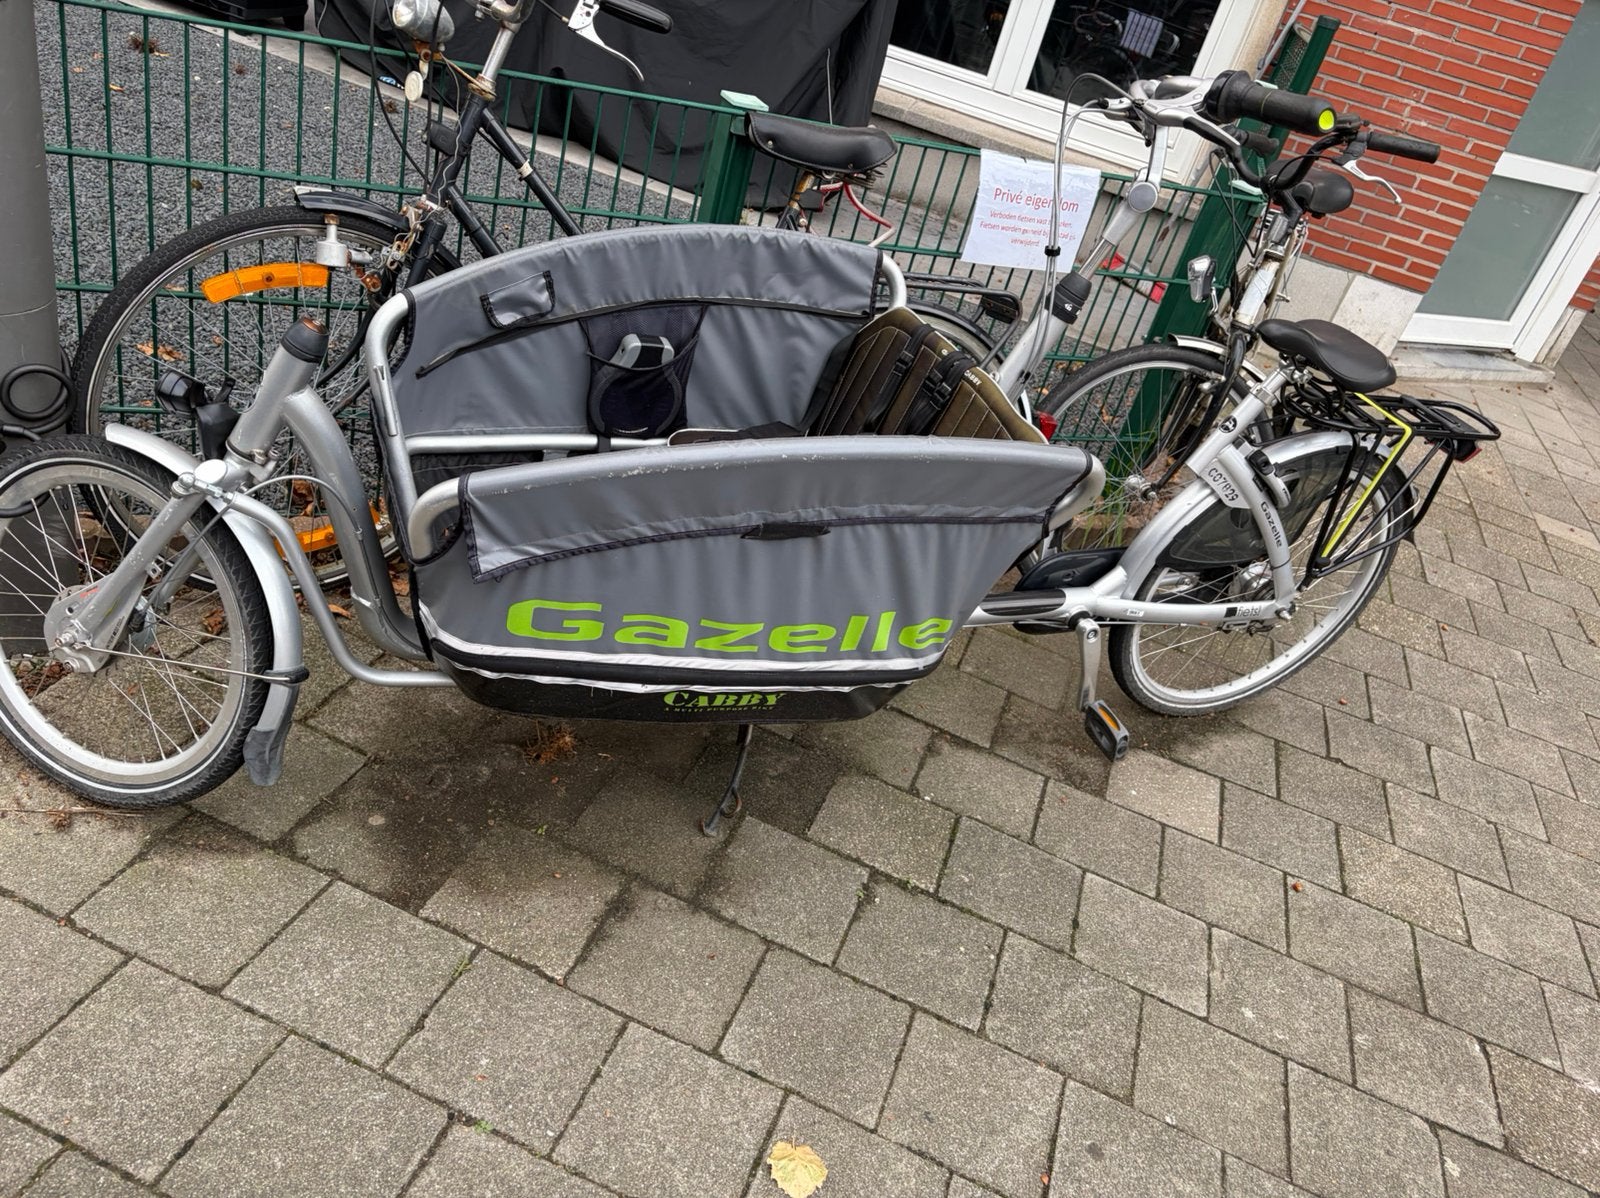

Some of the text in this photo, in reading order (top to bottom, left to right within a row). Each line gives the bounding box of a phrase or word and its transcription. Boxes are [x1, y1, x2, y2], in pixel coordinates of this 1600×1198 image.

[994, 188, 1023, 204] Privé
[990, 210, 1017, 220] Verboden
[979, 221, 1000, 231] Fietsen
[1000, 224, 1022, 233] worden
[964, 370, 982, 386] CABBY
[1207, 467, 1239, 502] C07829
[1260, 501, 1283, 548] Gazelle
[507, 599, 952, 652] Gazelle
[663, 691, 787, 707] CABBY
